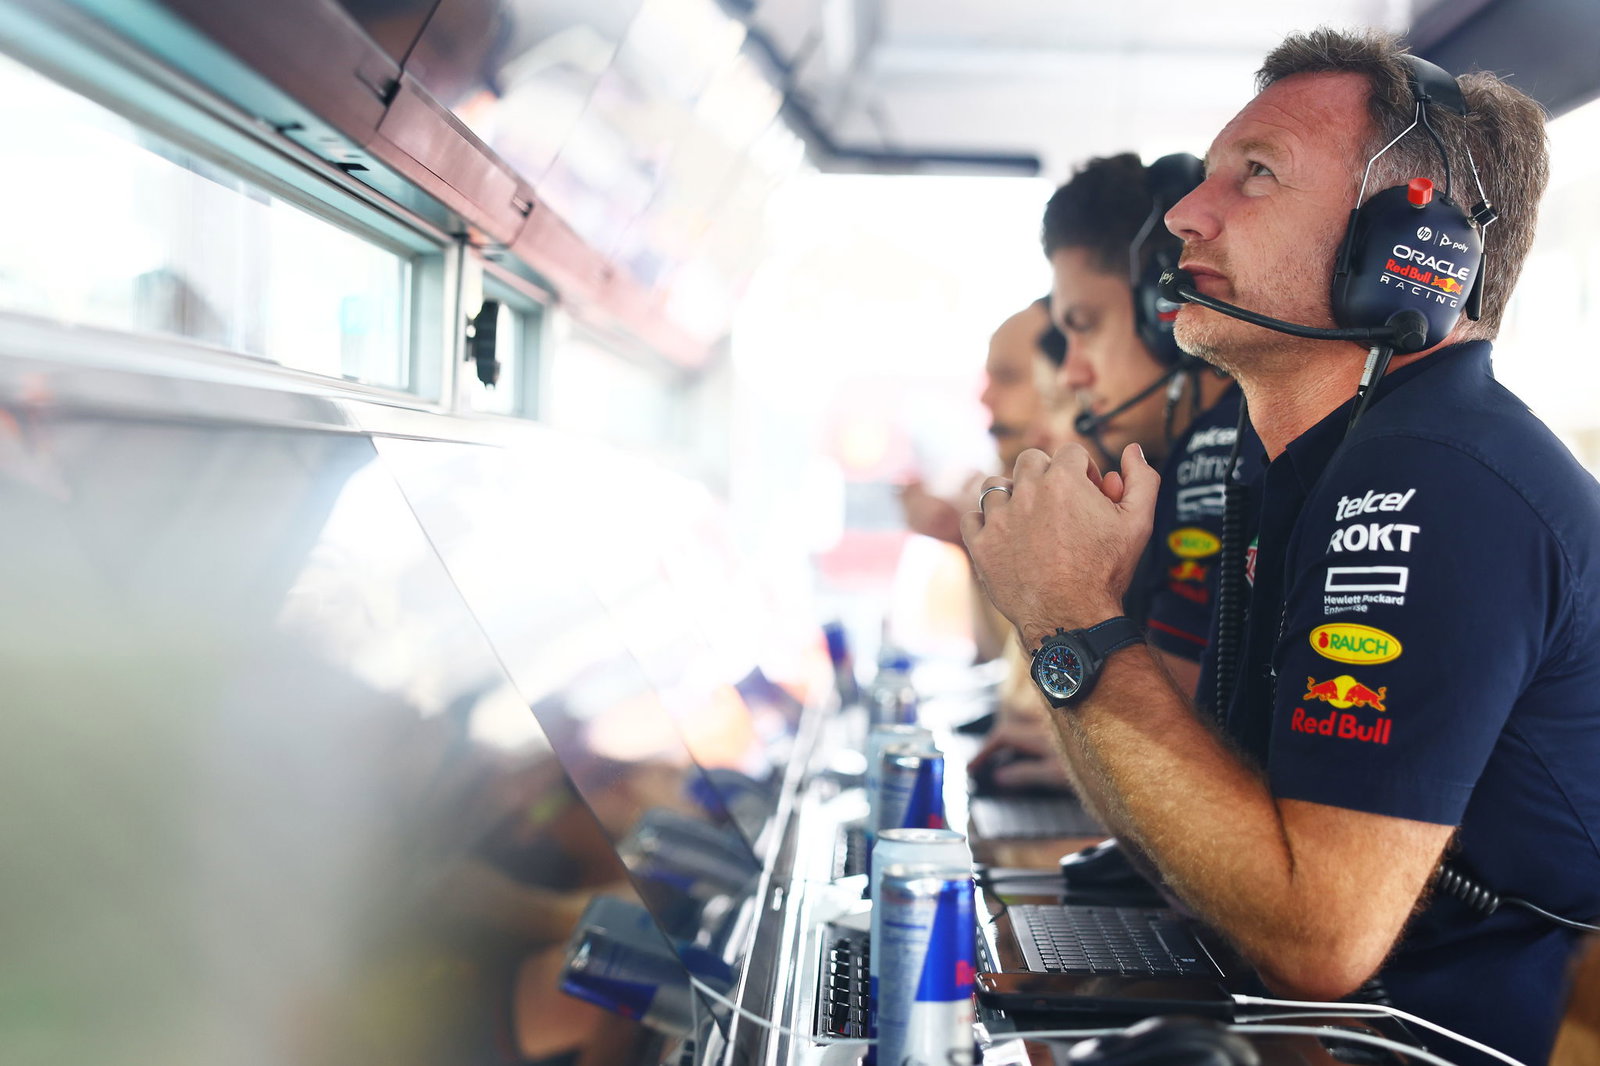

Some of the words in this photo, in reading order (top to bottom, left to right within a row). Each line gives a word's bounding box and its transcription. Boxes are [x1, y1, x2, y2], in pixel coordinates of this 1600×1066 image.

[1417, 226, 1432, 241] hp
[1452, 242, 1469, 253] poly
[1385, 259, 1411, 277] Red
[1409, 266, 1433, 284] Bull
[1393, 244, 1470, 281] ORACLE
[1380, 275, 1458, 308] RACING
[1335, 488, 1416, 522] telcel
[1326, 523, 1421, 555] ROKT
[1324, 594, 1361, 605] Hewlett
[1361, 593, 1405, 606] Packard
[1324, 604, 1368, 615] Enteise
[1330, 633, 1389, 656] RAUCH
[1291, 707, 1338, 737] Red
[1337, 713, 1392, 745] Bull
